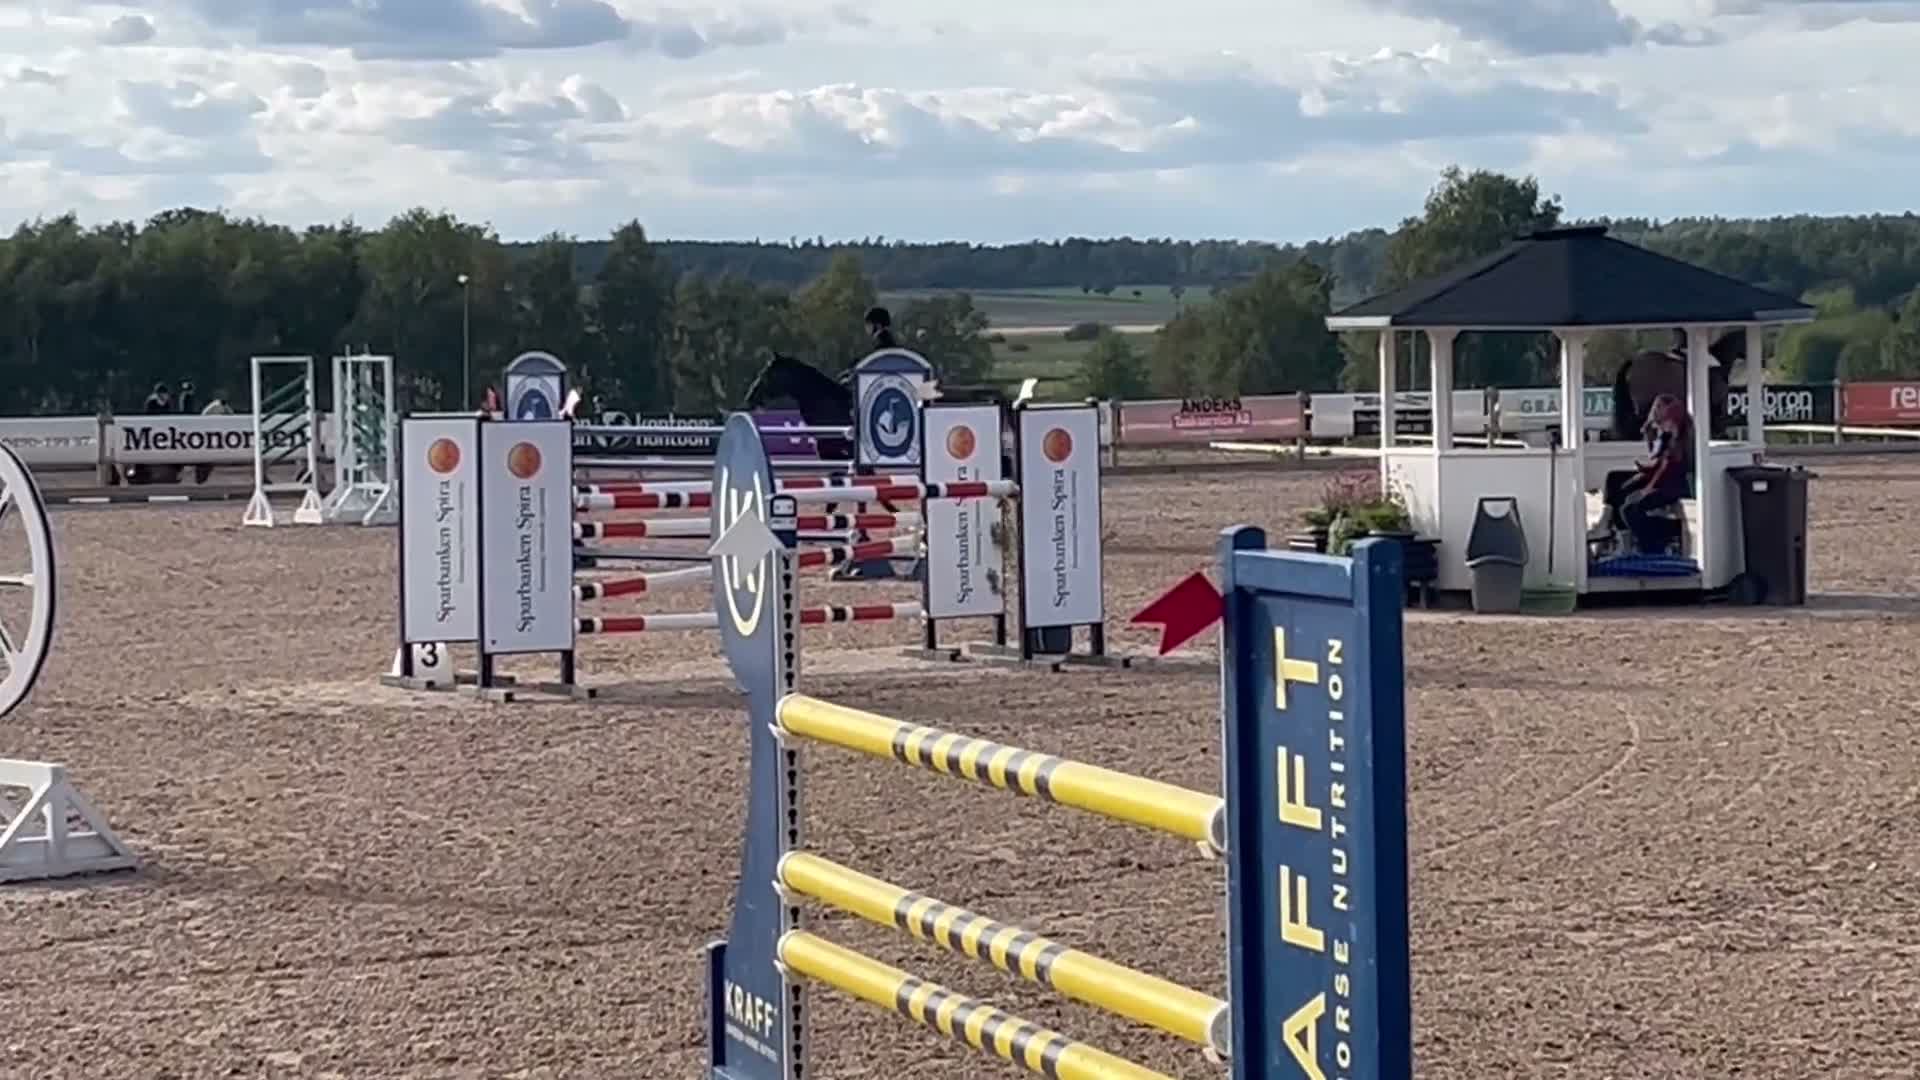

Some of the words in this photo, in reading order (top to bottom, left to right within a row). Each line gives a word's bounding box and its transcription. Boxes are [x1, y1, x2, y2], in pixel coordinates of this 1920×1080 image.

[1890, 387, 1920, 409] re
[437, 480, 454, 523] Spira
[517, 486, 535, 529] Spira
[1052, 469, 1070, 511] Spira
[437, 528, 455, 623] Sparbanken
[517, 534, 536, 632] Sparbanken
[954, 512, 973, 604] Sparbanken
[1053, 515, 1071, 608] Sparbanken
[421, 643, 438, 667] 3
[1327, 638, 1350, 911] NUTRITION
[725, 979, 778, 1038] KRAFF
[1331, 937, 1352, 1080] ORSE
